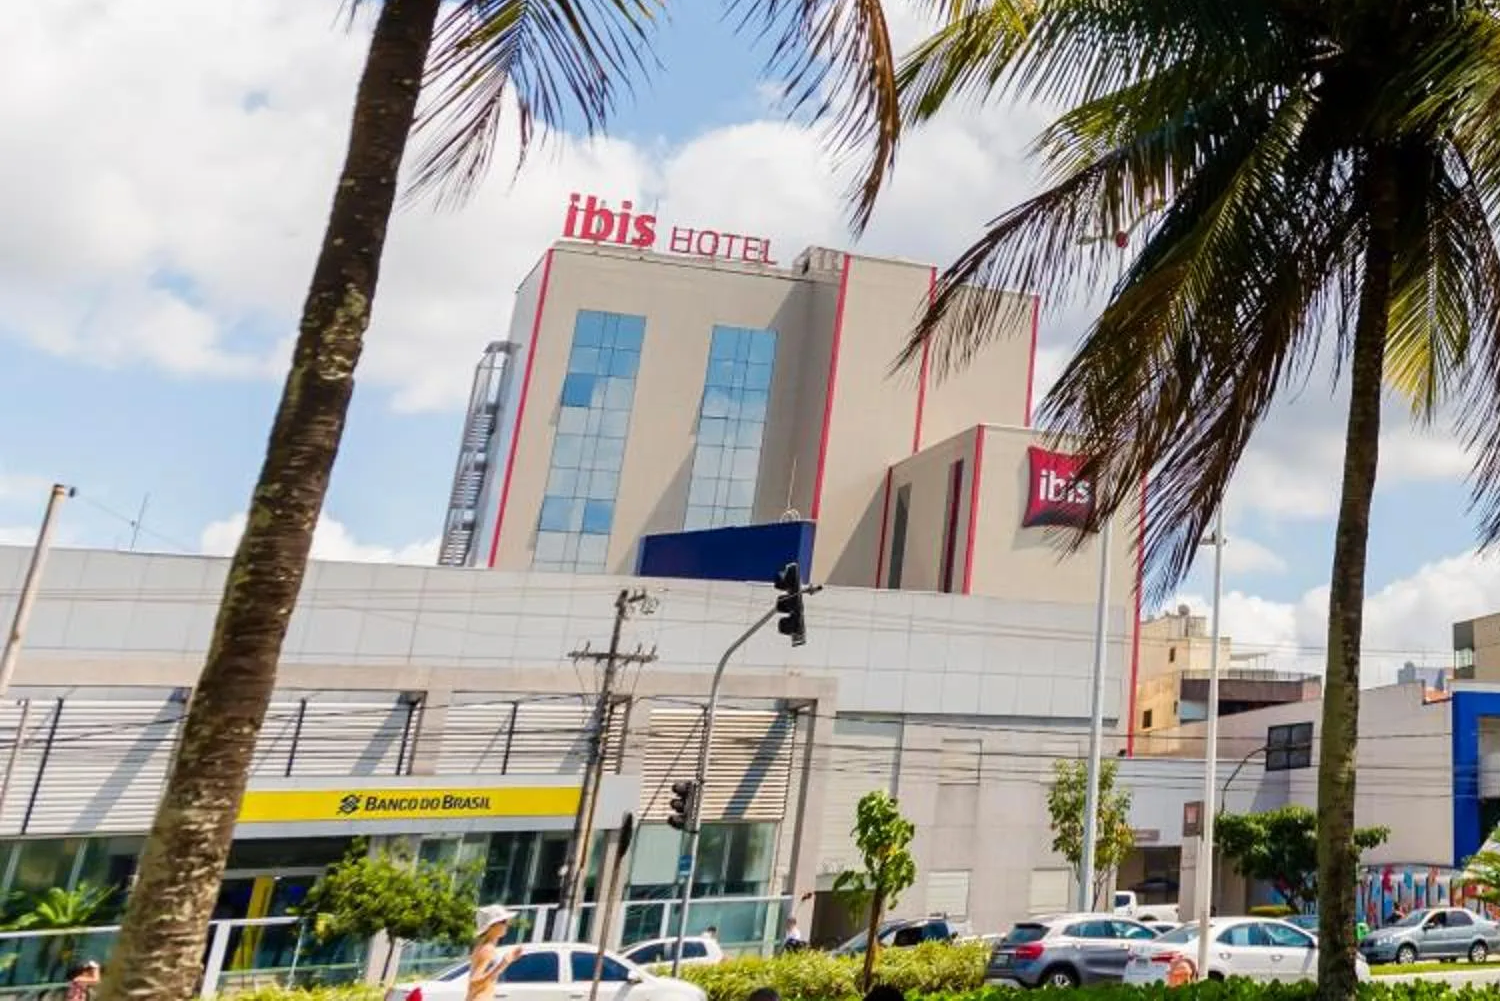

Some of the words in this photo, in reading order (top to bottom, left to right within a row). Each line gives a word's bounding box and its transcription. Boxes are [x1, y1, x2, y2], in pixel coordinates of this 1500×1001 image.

[563, 193, 657, 248] ibis
[670, 226, 778, 266] HOTEL
[365, 796, 417, 811] BANCO
[420, 797, 440, 810] DO
[442, 794, 491, 810] BRASIL
